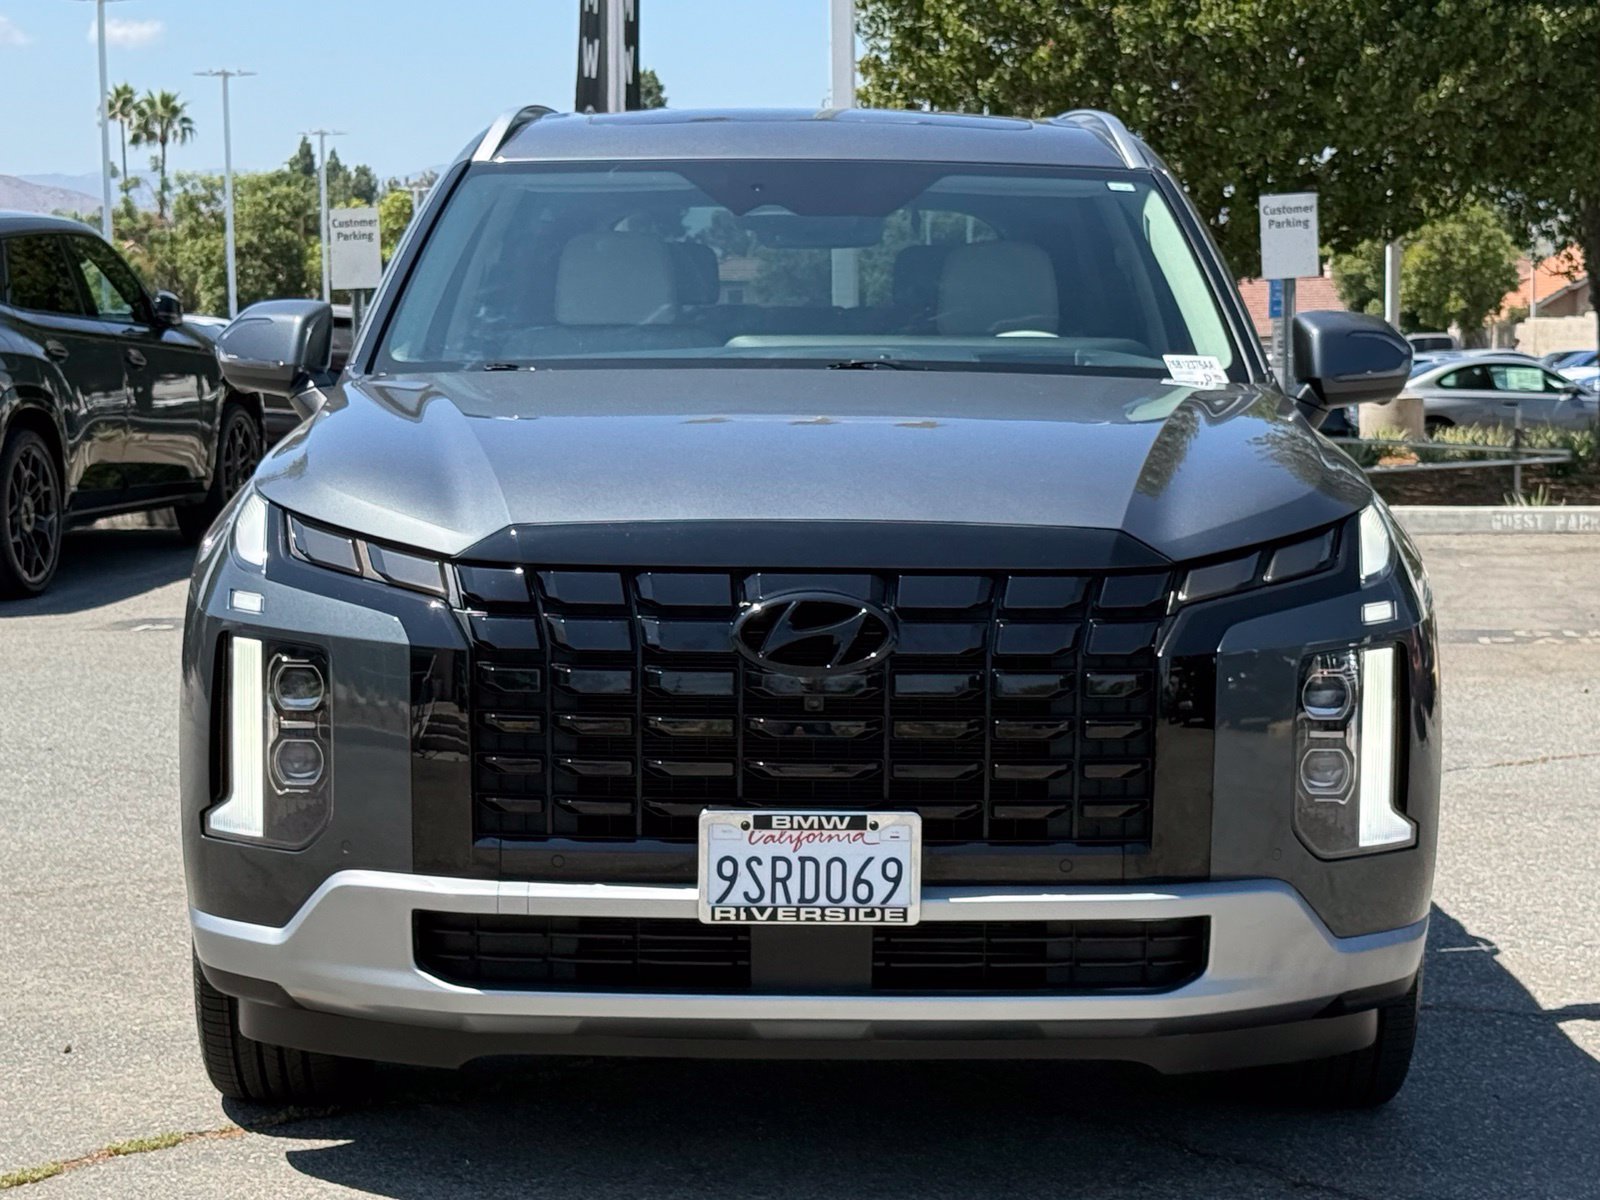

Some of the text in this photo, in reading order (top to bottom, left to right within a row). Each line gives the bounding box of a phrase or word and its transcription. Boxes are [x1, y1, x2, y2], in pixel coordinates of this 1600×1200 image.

[1262, 204, 1314, 216] Customer
[331, 219, 377, 228] Customer
[1267, 218, 1311, 230] Parking
[336, 231, 374, 242] Parking
[1491, 513, 1543, 530] GUEST
[771, 815, 851, 830] BMW
[748, 830, 881, 853] California
[715, 855, 904, 904] 9SRD069
[714, 907, 905, 922] RIVERSIDE
